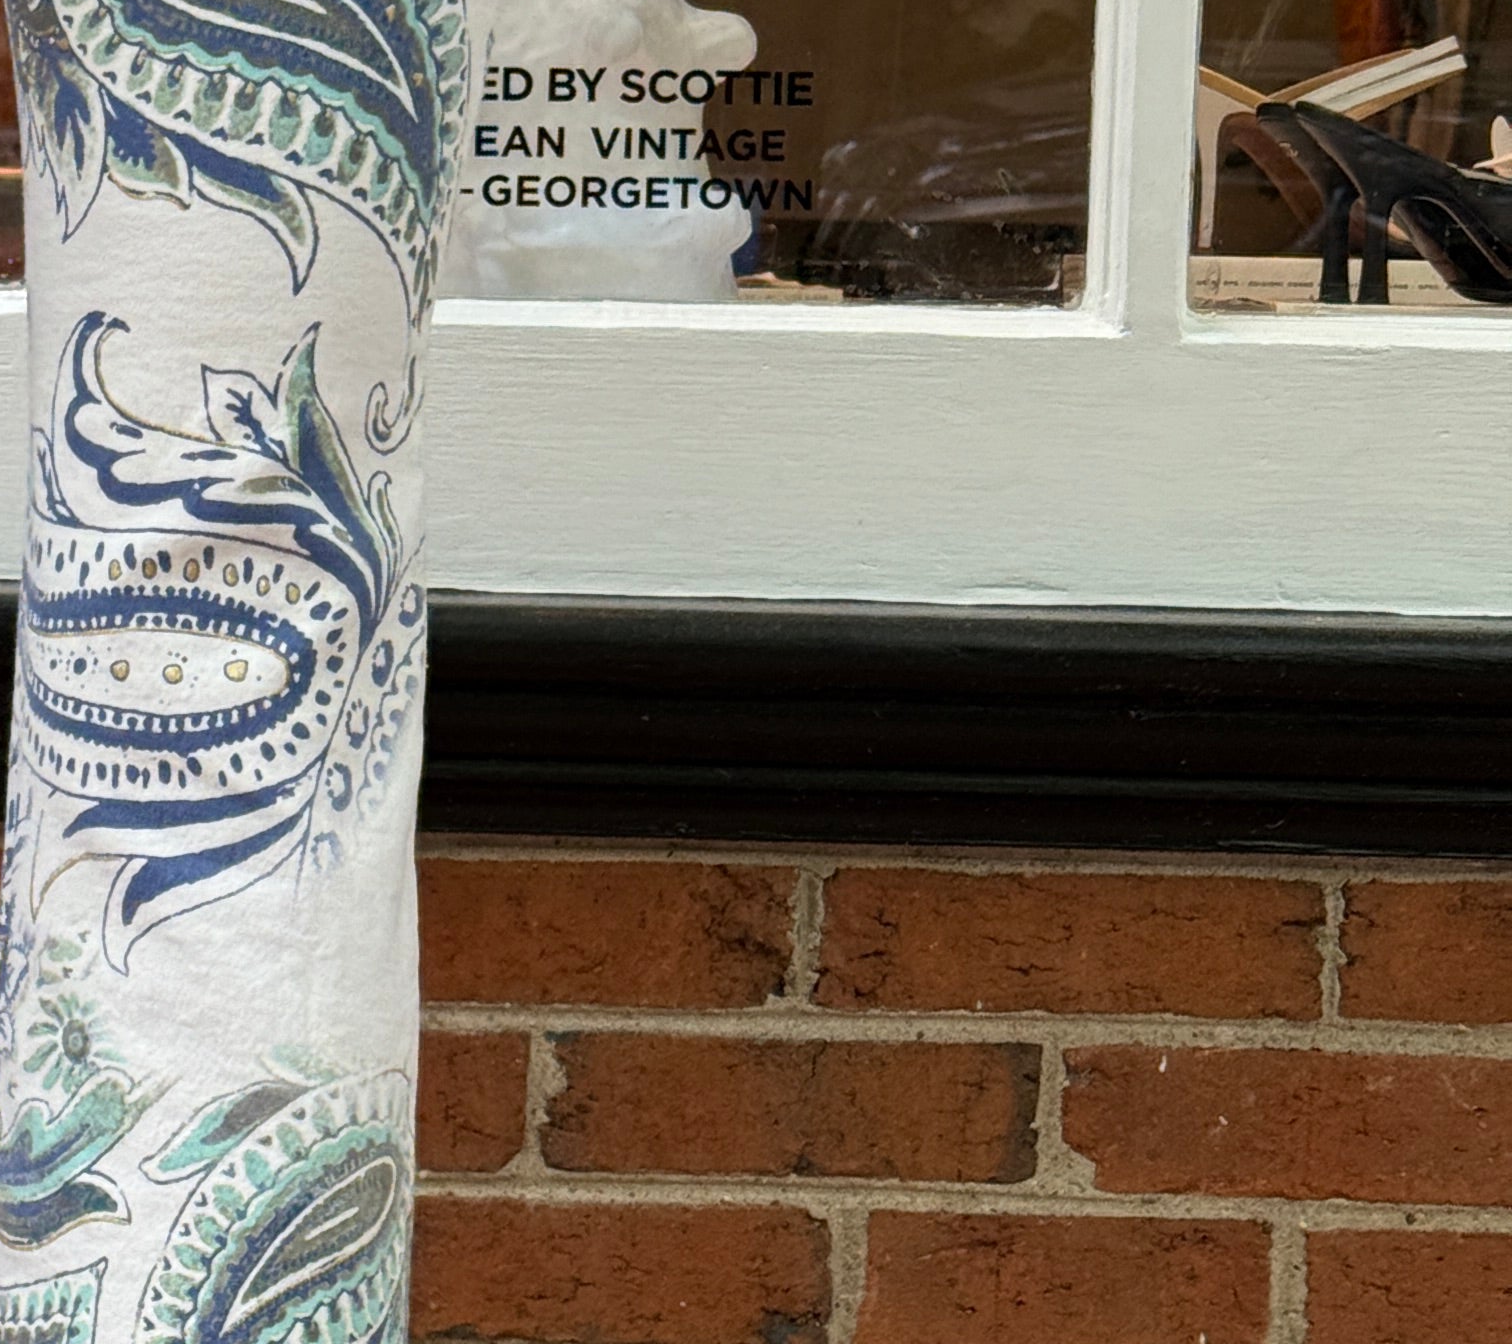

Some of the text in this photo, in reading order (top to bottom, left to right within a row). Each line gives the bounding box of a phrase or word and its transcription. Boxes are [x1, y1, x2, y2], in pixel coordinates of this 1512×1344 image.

[548, 66, 606, 102] BY
[620, 67, 814, 107] SCOTTIE
[591, 126, 786, 162] VINTAGE
